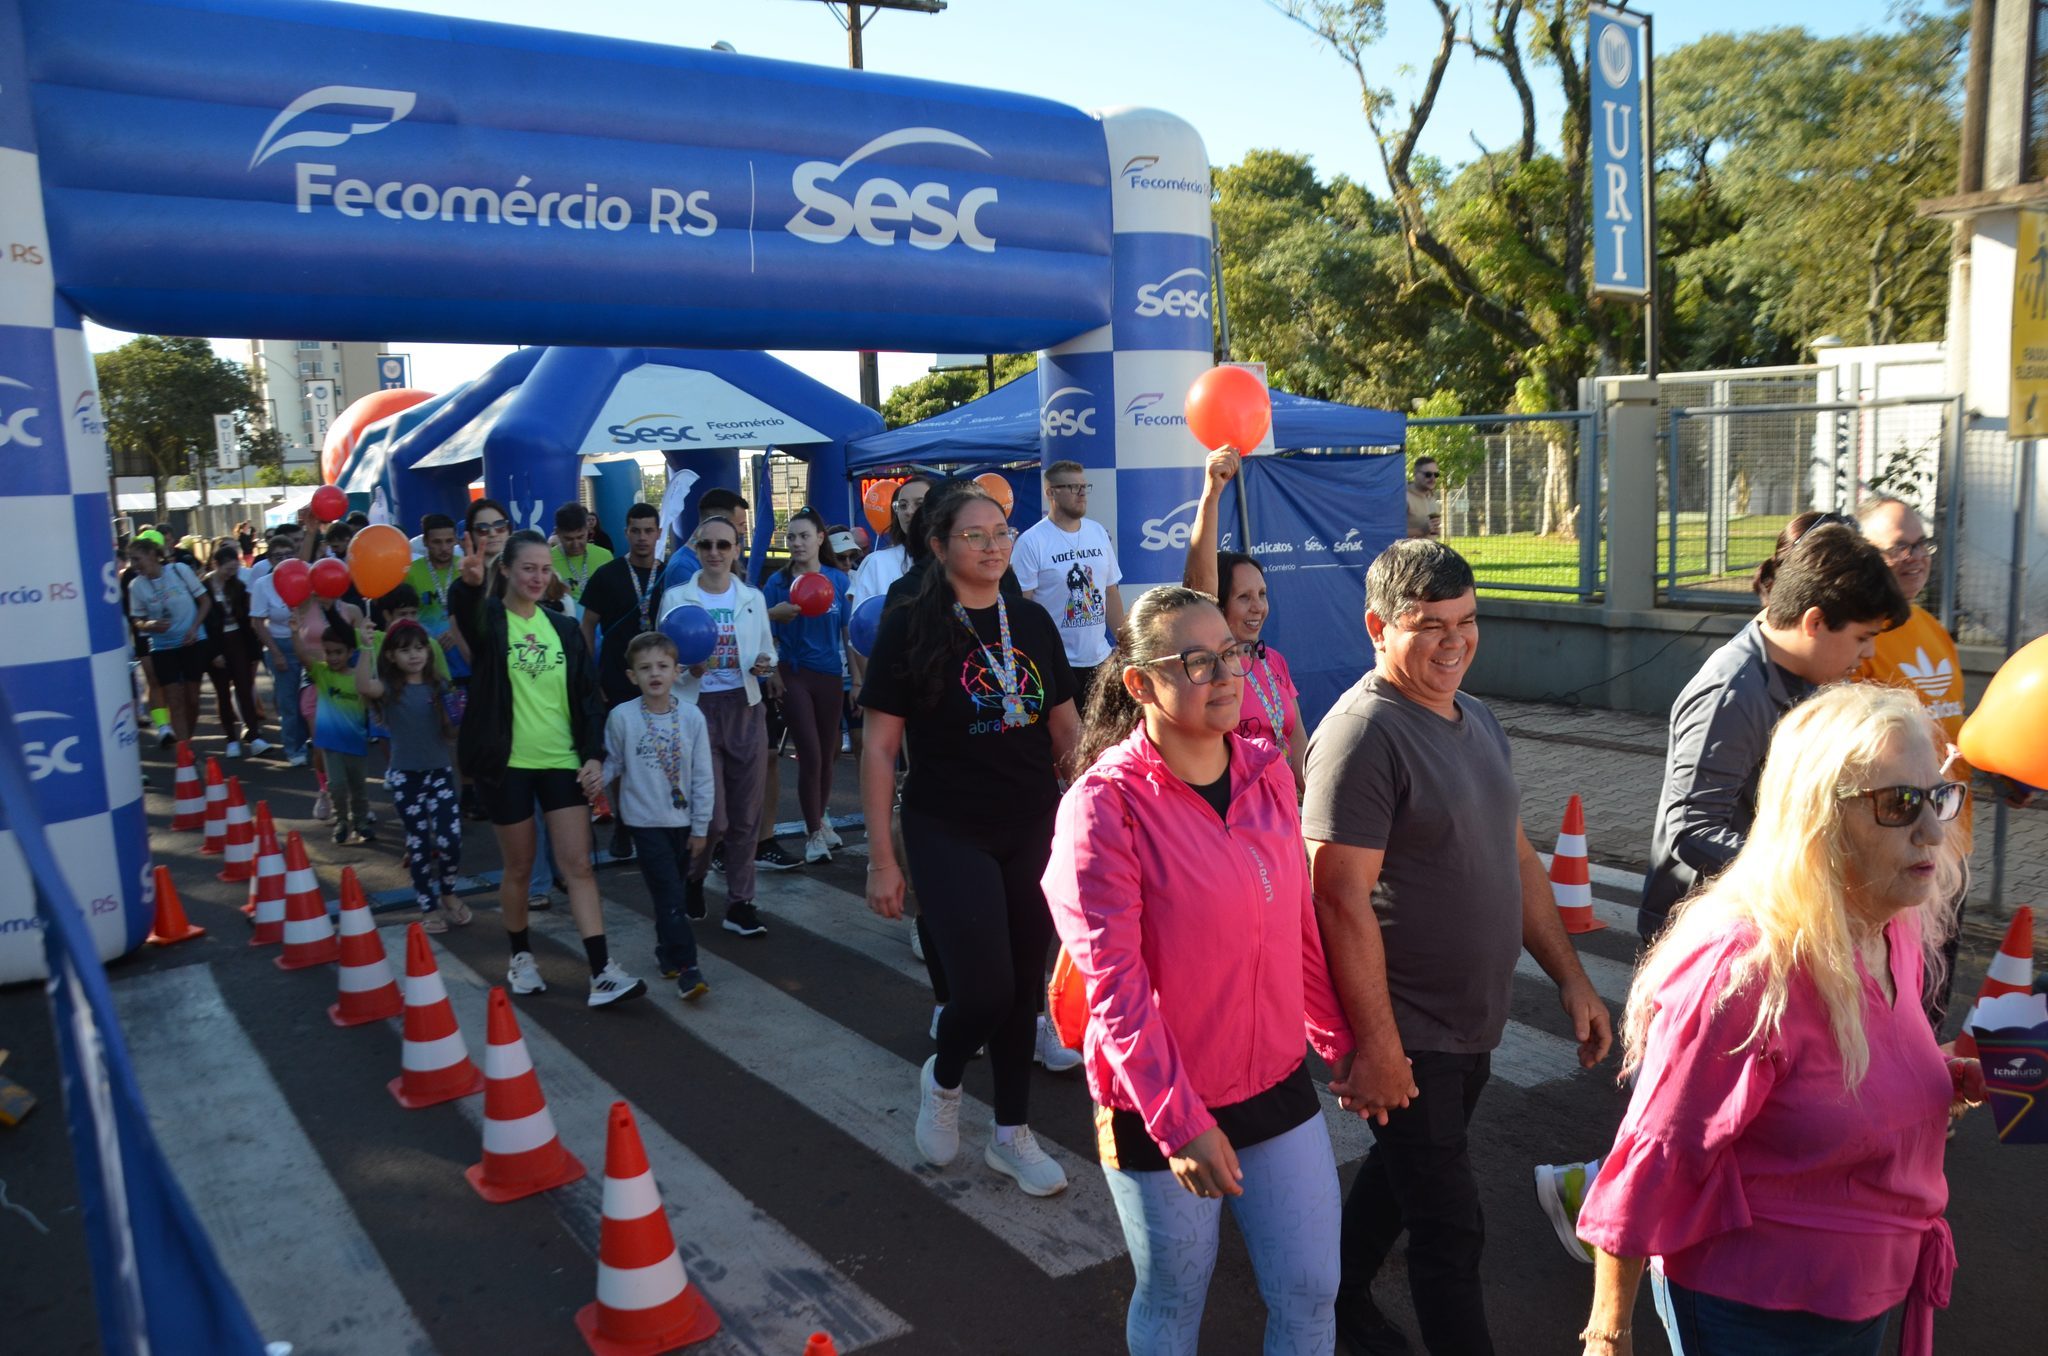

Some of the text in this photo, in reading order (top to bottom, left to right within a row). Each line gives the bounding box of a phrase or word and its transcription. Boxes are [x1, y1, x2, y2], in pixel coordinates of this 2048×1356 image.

[1131, 175, 1203, 195] Fecomércio
[1602, 100, 1632, 281] URI
[296, 162, 719, 238] Fecomércio RS
[785, 160, 999, 253] Sesc
[10, 243, 44, 265] RS
[608, 416, 785, 445] Sesc Fecomércio
[1051, 548, 1104, 564] VOCÊ NUNCA
[48, 582, 78, 602] RS
[92, 894, 119, 916] RS
